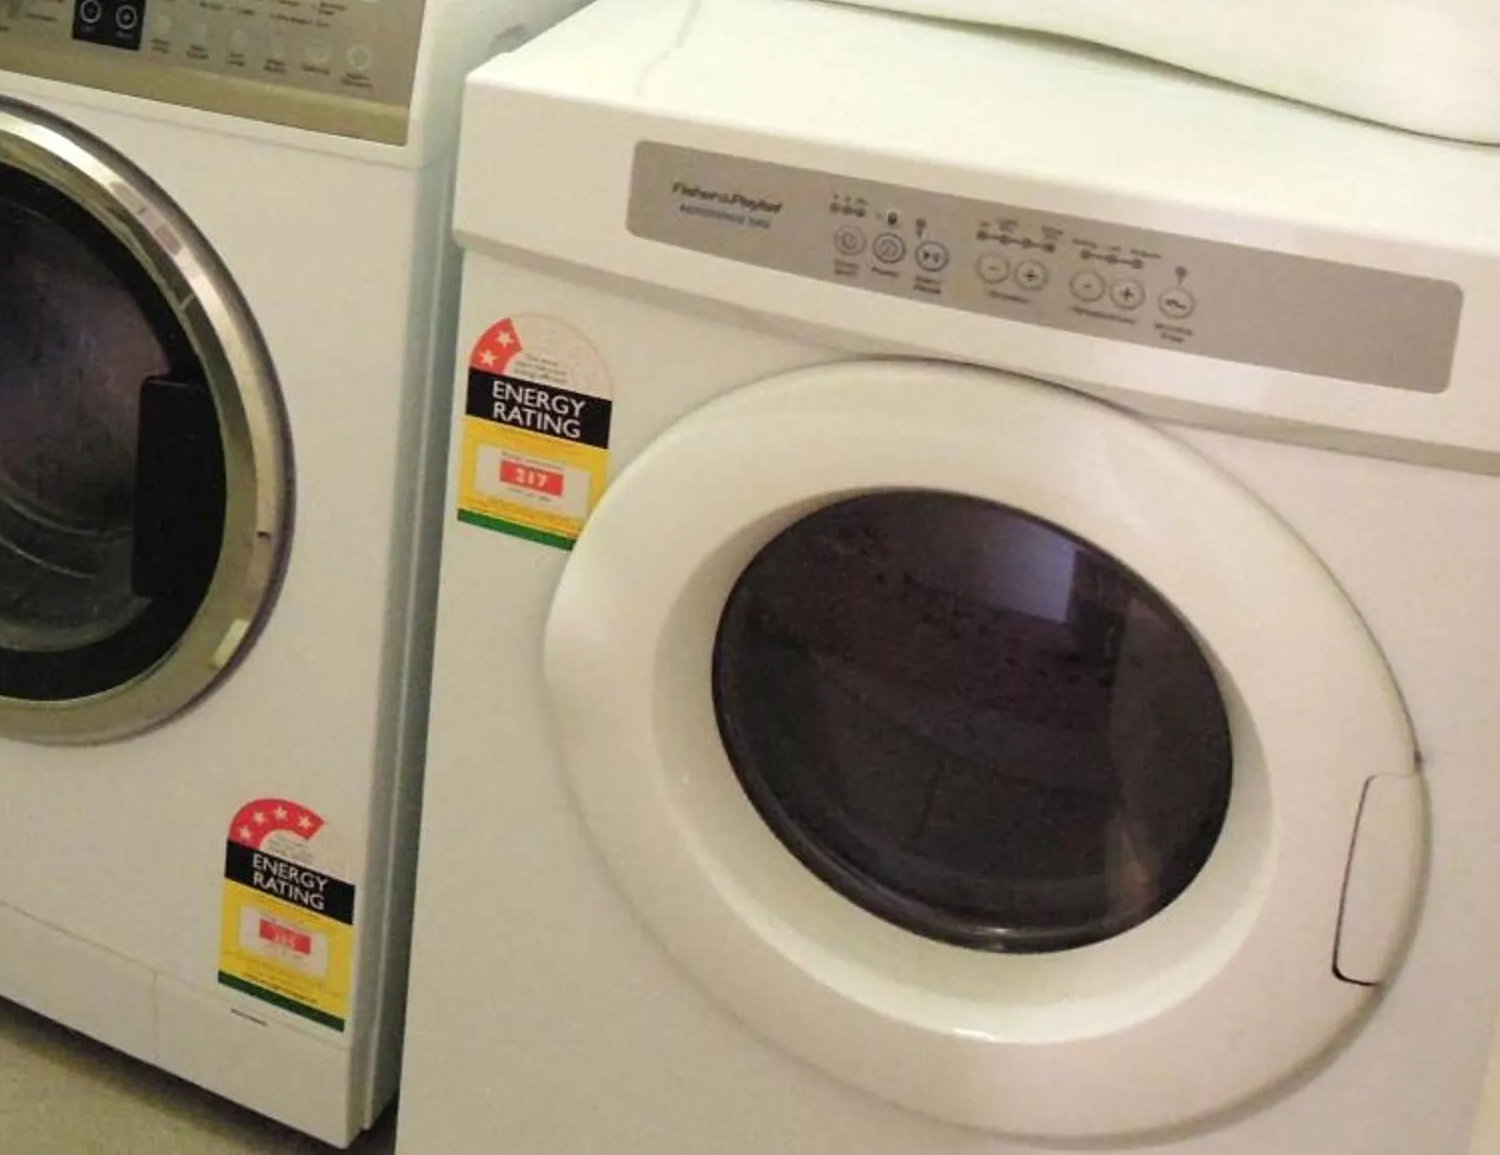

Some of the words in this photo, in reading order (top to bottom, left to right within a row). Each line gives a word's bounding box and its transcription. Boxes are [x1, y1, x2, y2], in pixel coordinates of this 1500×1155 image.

[492, 379, 587, 417] ENERGY
[492, 401, 582, 439] RATING
[252, 852, 329, 892] ENERGY
[252, 872, 325, 912] RATING
